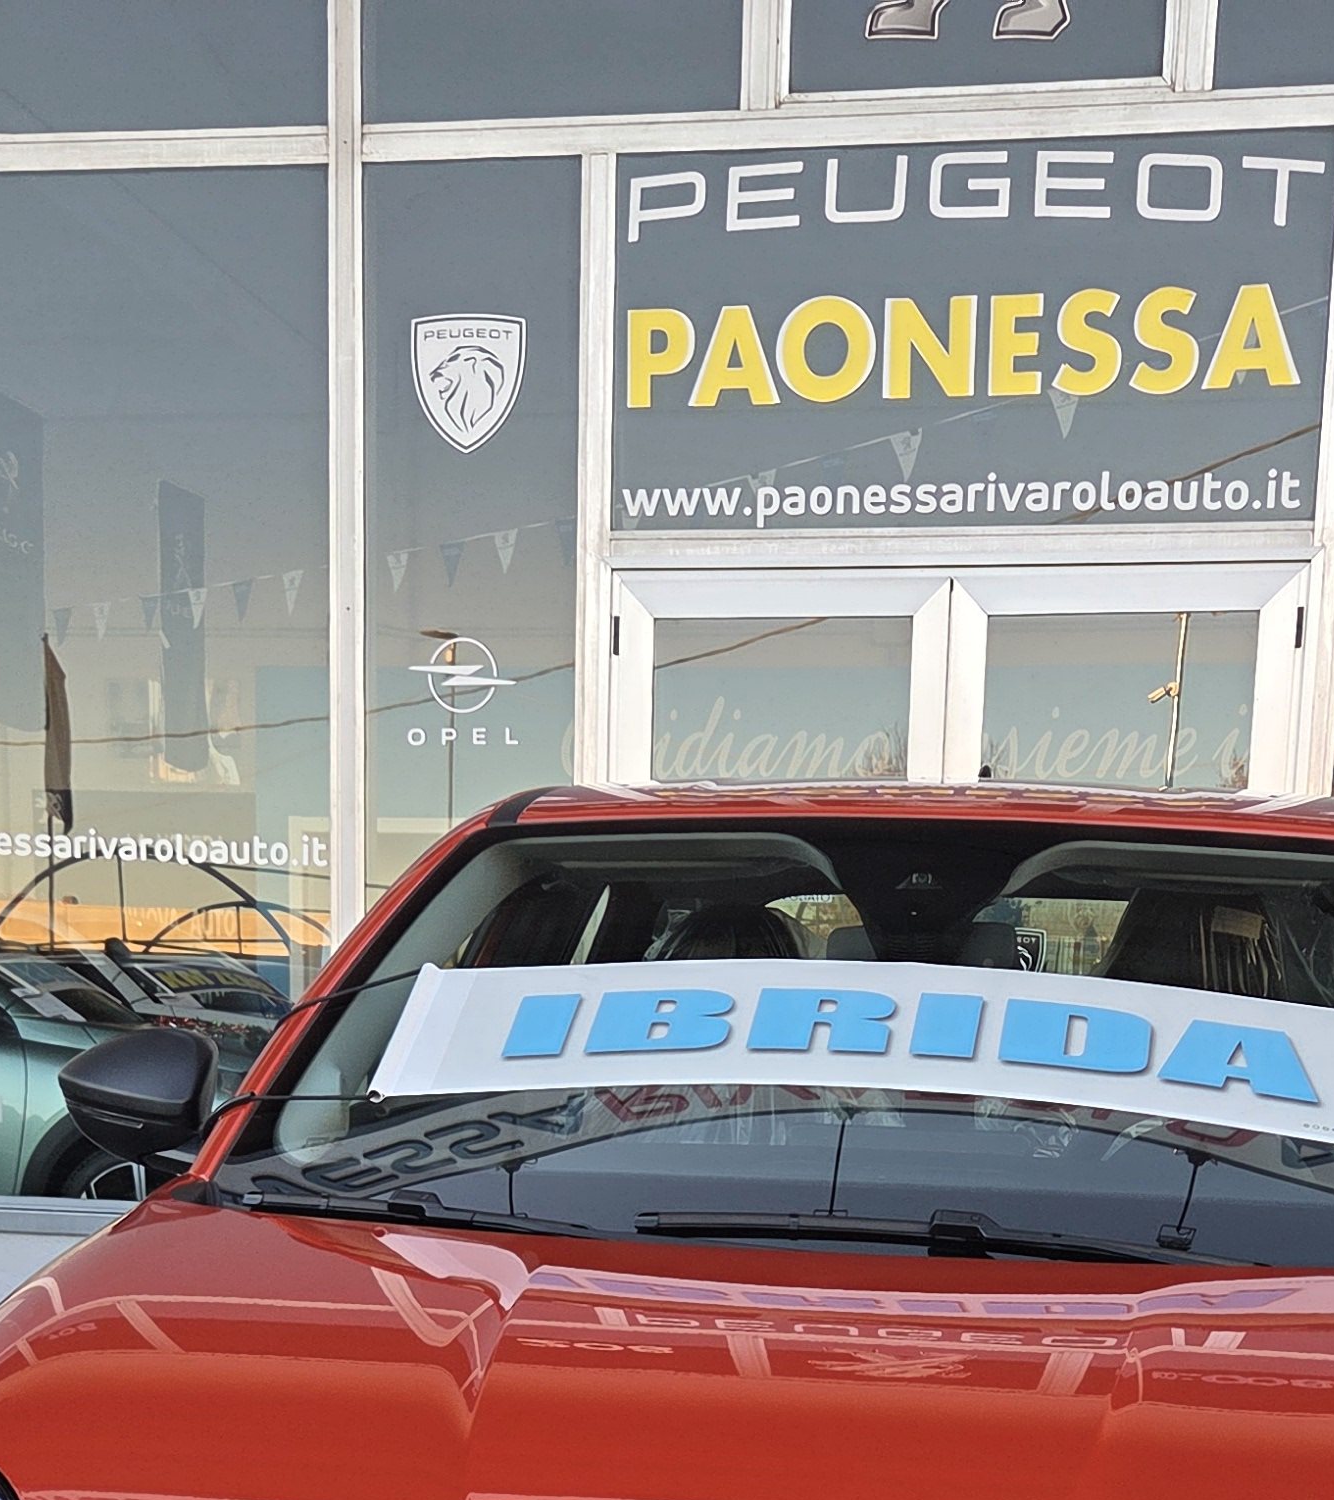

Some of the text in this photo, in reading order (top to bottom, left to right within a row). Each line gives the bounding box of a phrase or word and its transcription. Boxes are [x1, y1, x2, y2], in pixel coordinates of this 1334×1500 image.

[627, 150, 1326, 243] PEUGEOT
[424, 328, 513, 341] PEUGEOT
[627, 284, 1301, 408] PAONESSA
[623, 469, 1301, 528] www.paonessarivaroloauto.it
[407, 727, 519, 745] OPEL
[501, 986, 1324, 1107] IBRIDA
